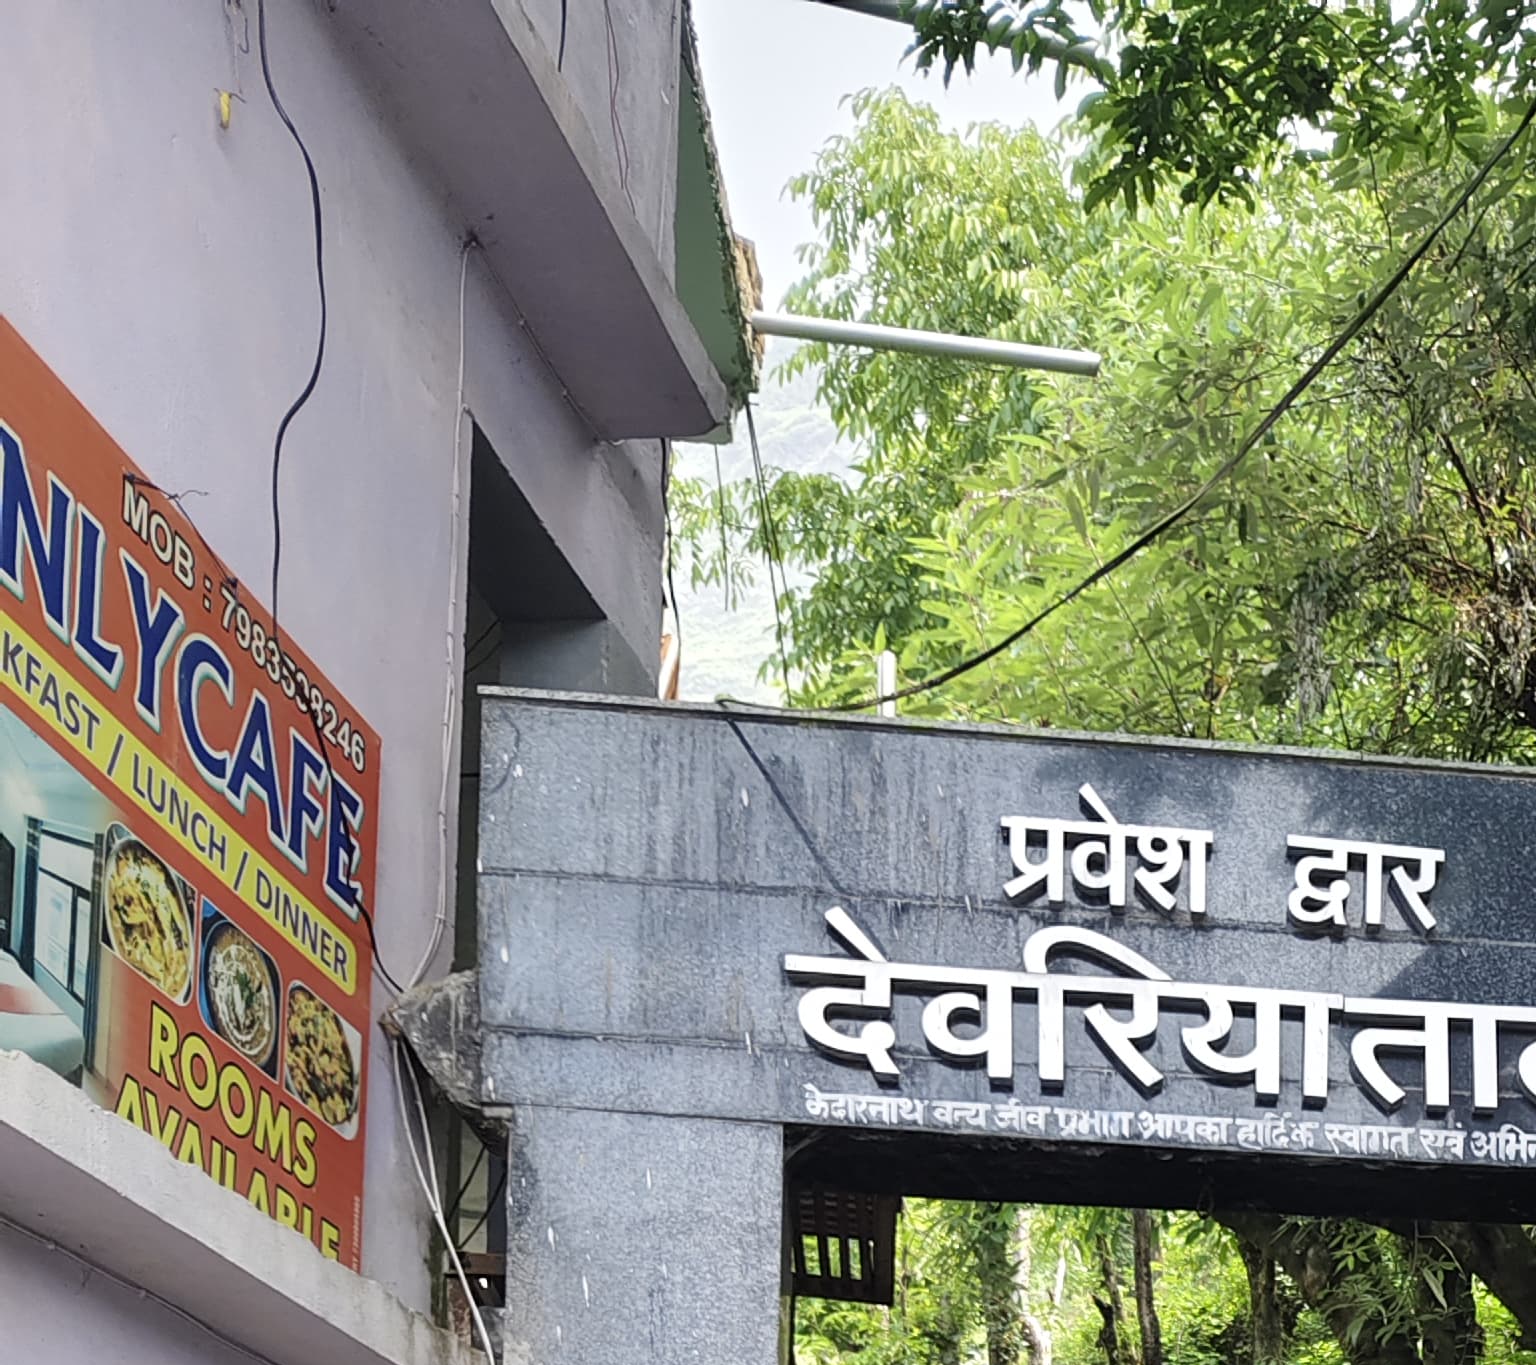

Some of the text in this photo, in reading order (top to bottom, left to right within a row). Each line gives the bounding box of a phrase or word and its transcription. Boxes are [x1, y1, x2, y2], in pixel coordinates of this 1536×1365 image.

[122, 475, 195, 590] MOB
[132, 752, 228, 871] LUNCH
[256, 868, 349, 985] DINNER
[1001, 783, 1446, 930] प्रवेश द्वार
[149, 1001, 317, 1188] ROOMS
[803, 1082, 929, 1125] केदारनाथ
[932, 1100, 992, 1127] वन्य
[1137, 1110, 1234, 1144] आपका
